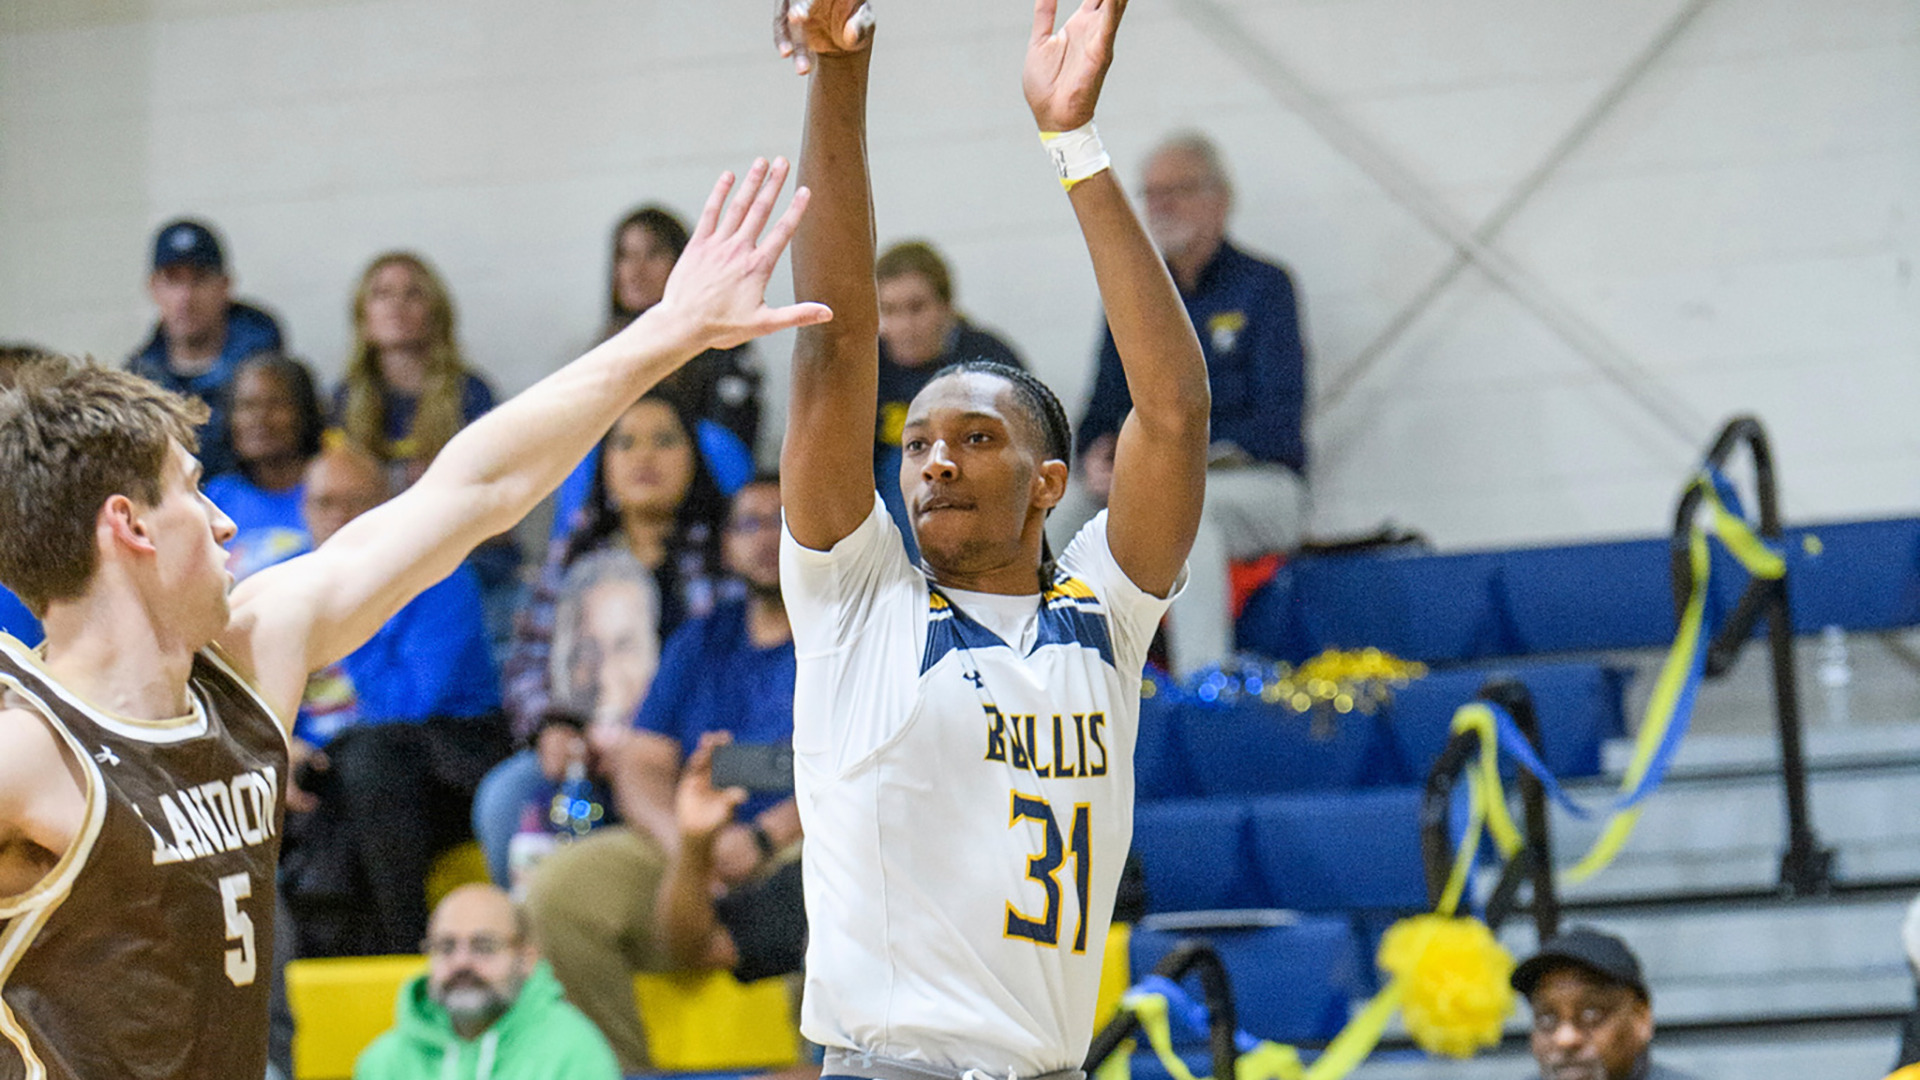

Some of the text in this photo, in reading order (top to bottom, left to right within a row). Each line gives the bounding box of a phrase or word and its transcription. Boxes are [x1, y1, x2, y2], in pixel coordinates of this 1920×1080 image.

[982, 703, 1108, 778] BULLIS
[219, 872, 256, 987] 5
[1003, 789, 1092, 955] 31
